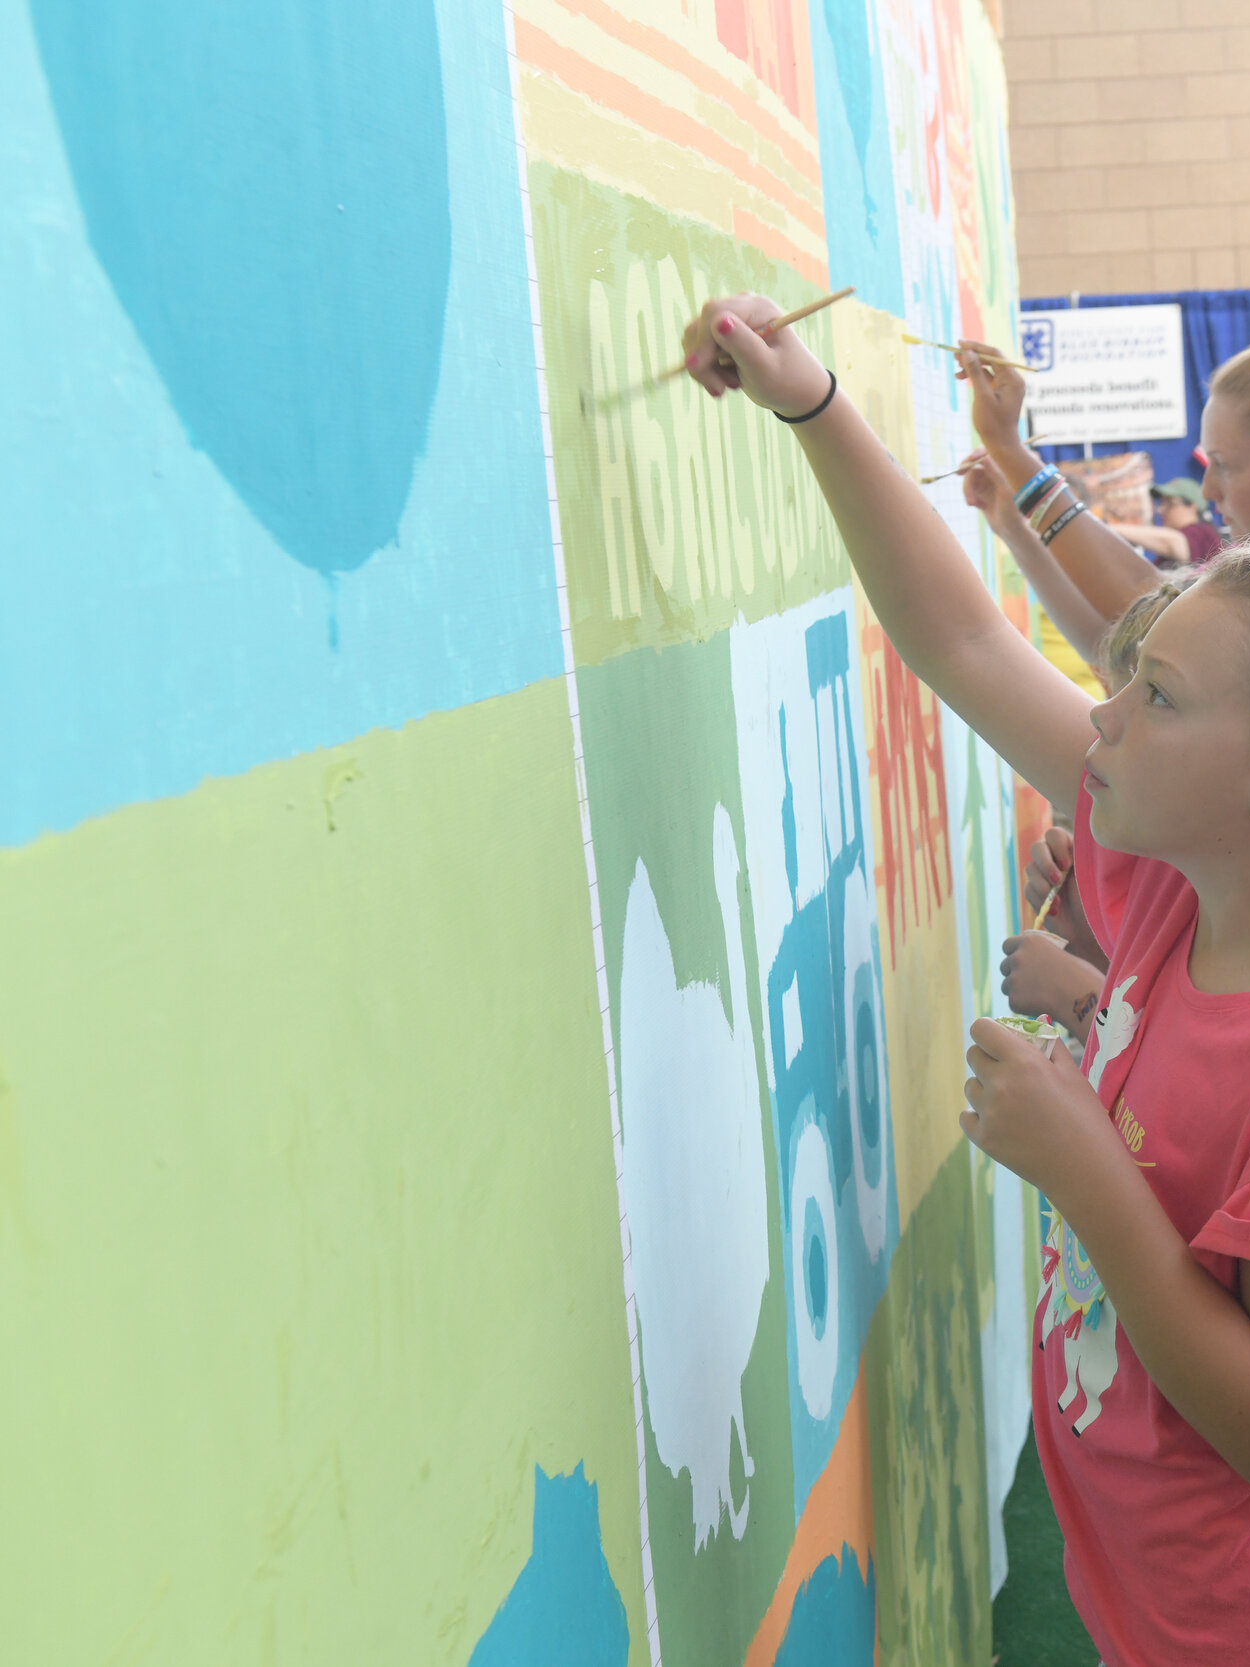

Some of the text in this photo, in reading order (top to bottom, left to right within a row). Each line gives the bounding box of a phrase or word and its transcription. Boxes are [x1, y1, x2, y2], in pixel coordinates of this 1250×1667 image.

[1038, 381, 1103, 399] proceeds
[1108, 378, 1158, 393] benefit
[1118, 1105, 1146, 1153] PROB
